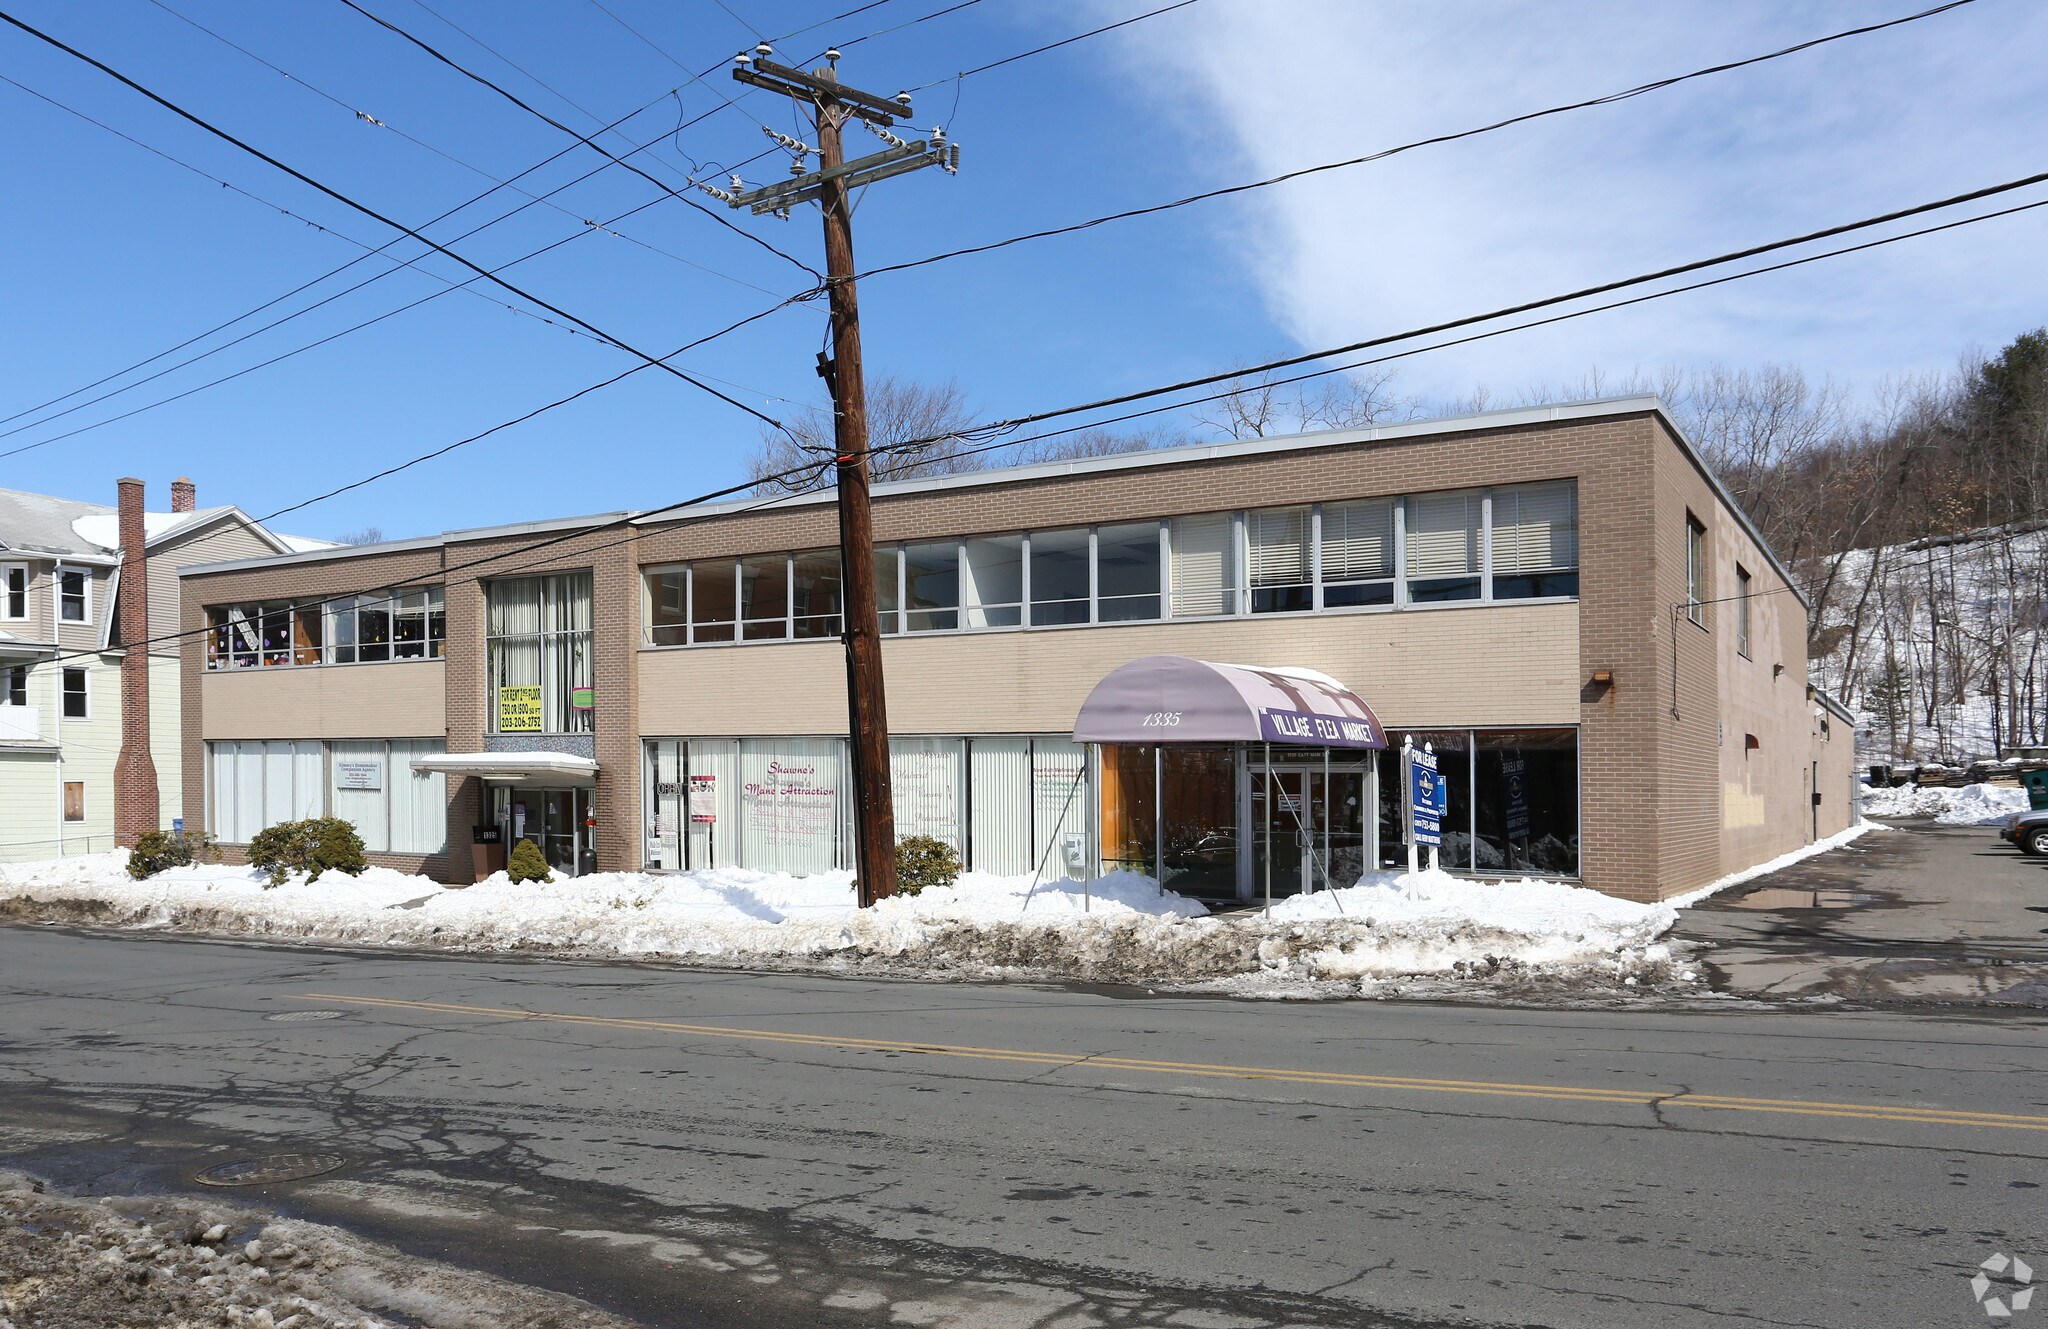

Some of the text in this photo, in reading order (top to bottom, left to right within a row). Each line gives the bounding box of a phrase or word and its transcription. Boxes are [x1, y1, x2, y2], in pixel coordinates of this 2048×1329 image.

[510, 689, 520, 701] RENT
[529, 688, 541, 701] FLOOR
[502, 704, 511, 715] 750
[511, 704, 517, 715] OR
[518, 703, 529, 715] 1500
[1143, 712, 1182, 727] 1335
[1270, 713, 1374, 743] VILLAGE FLEA MARKET
[1412, 749, 1437, 769] FOR LEASE
[767, 762, 815, 775] Shawne's
[657, 783, 683, 795] OPEN
[780, 784, 834, 796] Attraction
